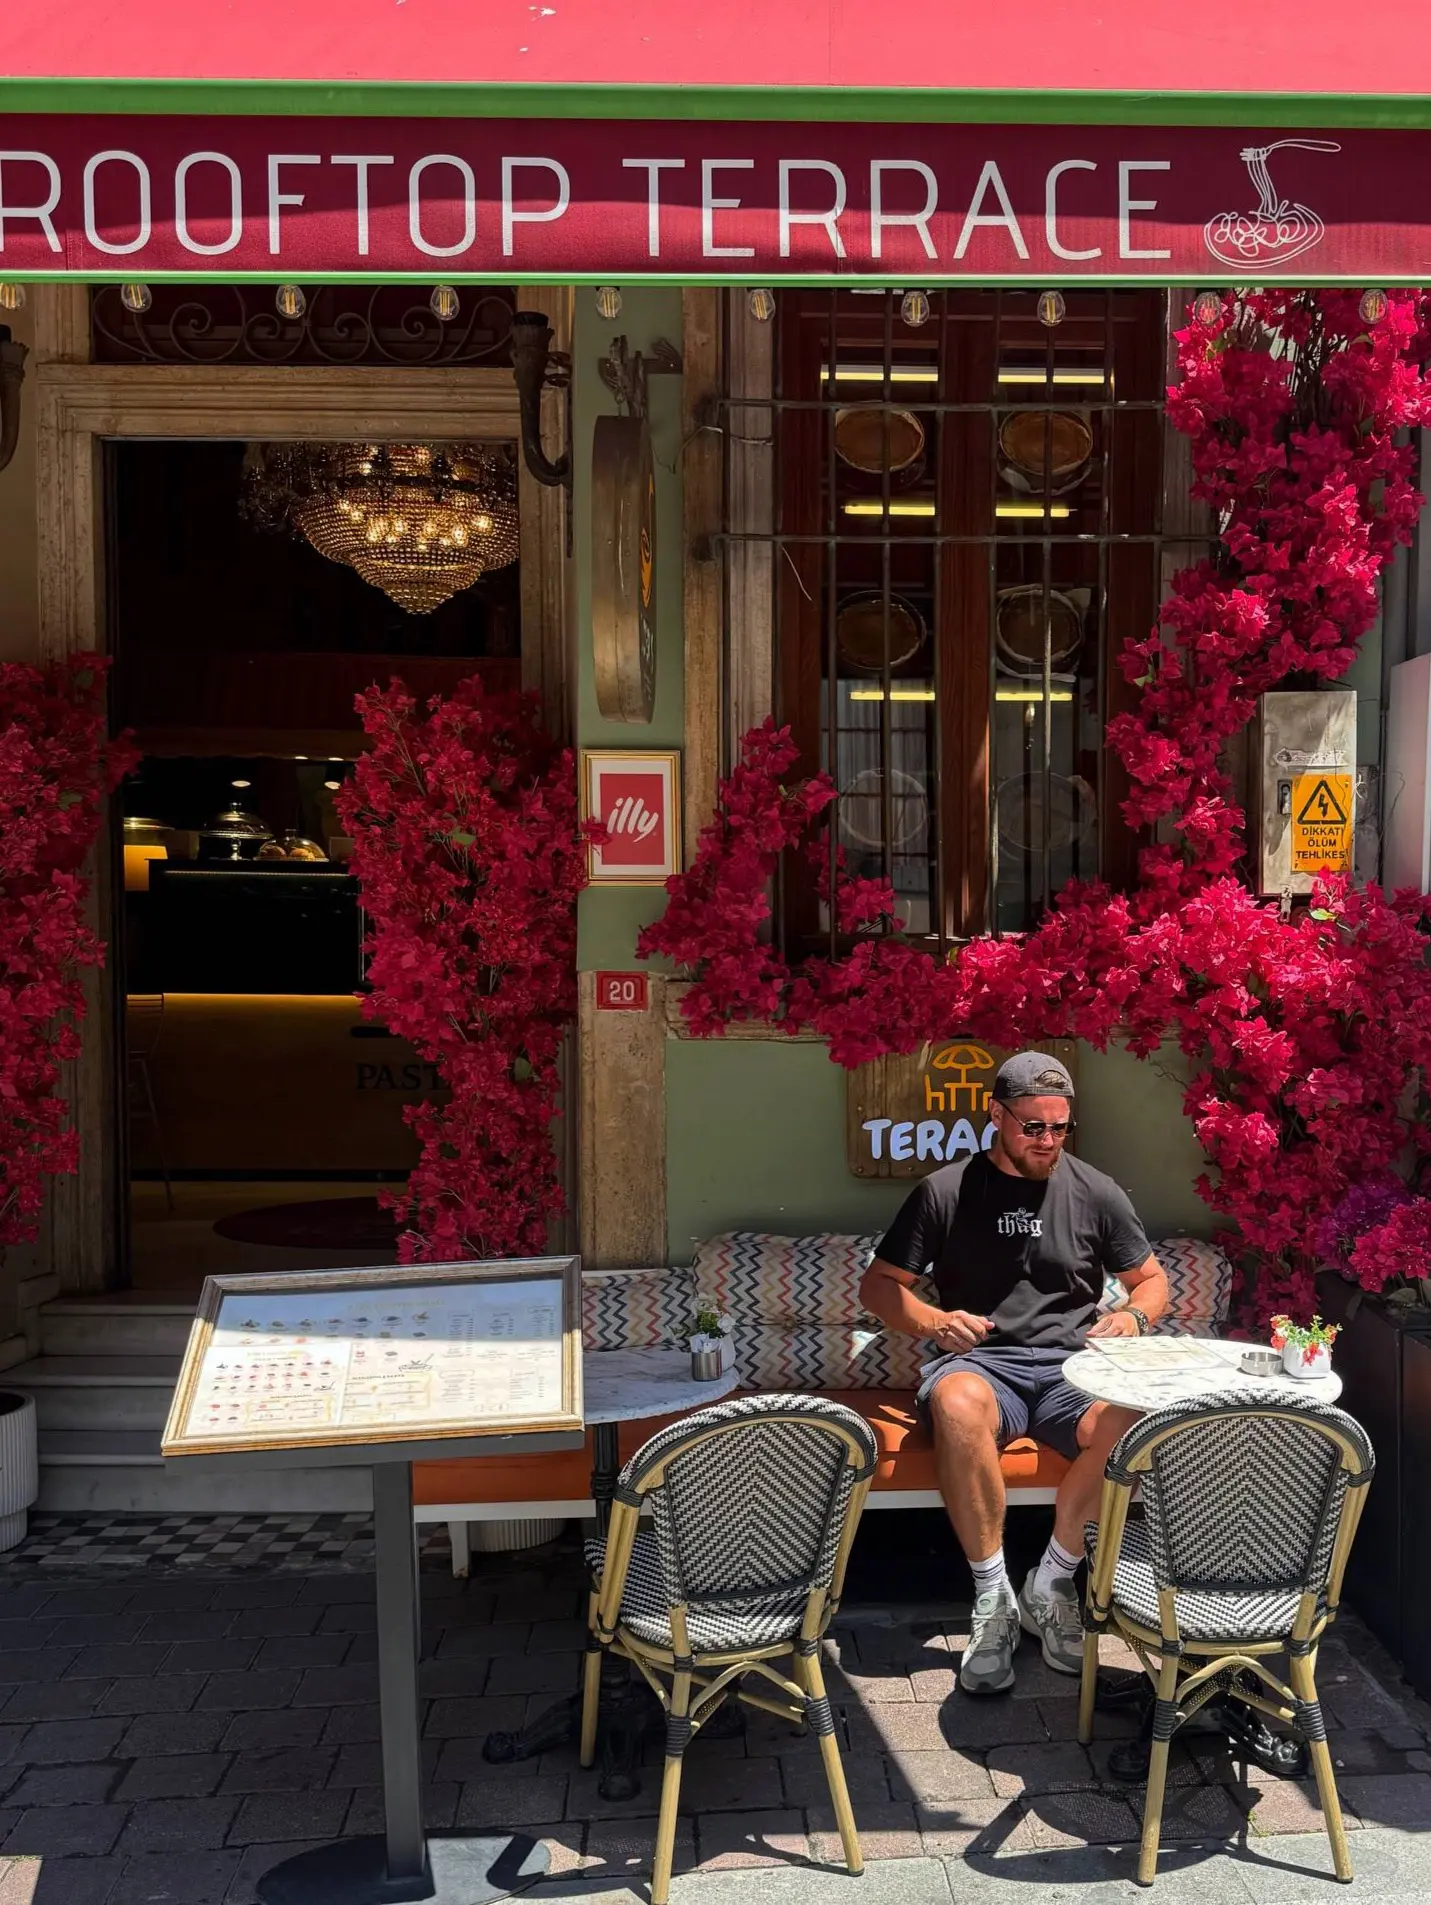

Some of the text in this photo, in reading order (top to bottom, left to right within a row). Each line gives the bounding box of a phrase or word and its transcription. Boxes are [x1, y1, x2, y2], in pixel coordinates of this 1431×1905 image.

[0, 150, 1172, 261] ROOFTOP TERRACE
[606, 796, 659, 842] illy
[1307, 836, 1337, 847] ÖLÜM
[609, 980, 635, 1001] 20
[355, 1063, 451, 1091] PAST
